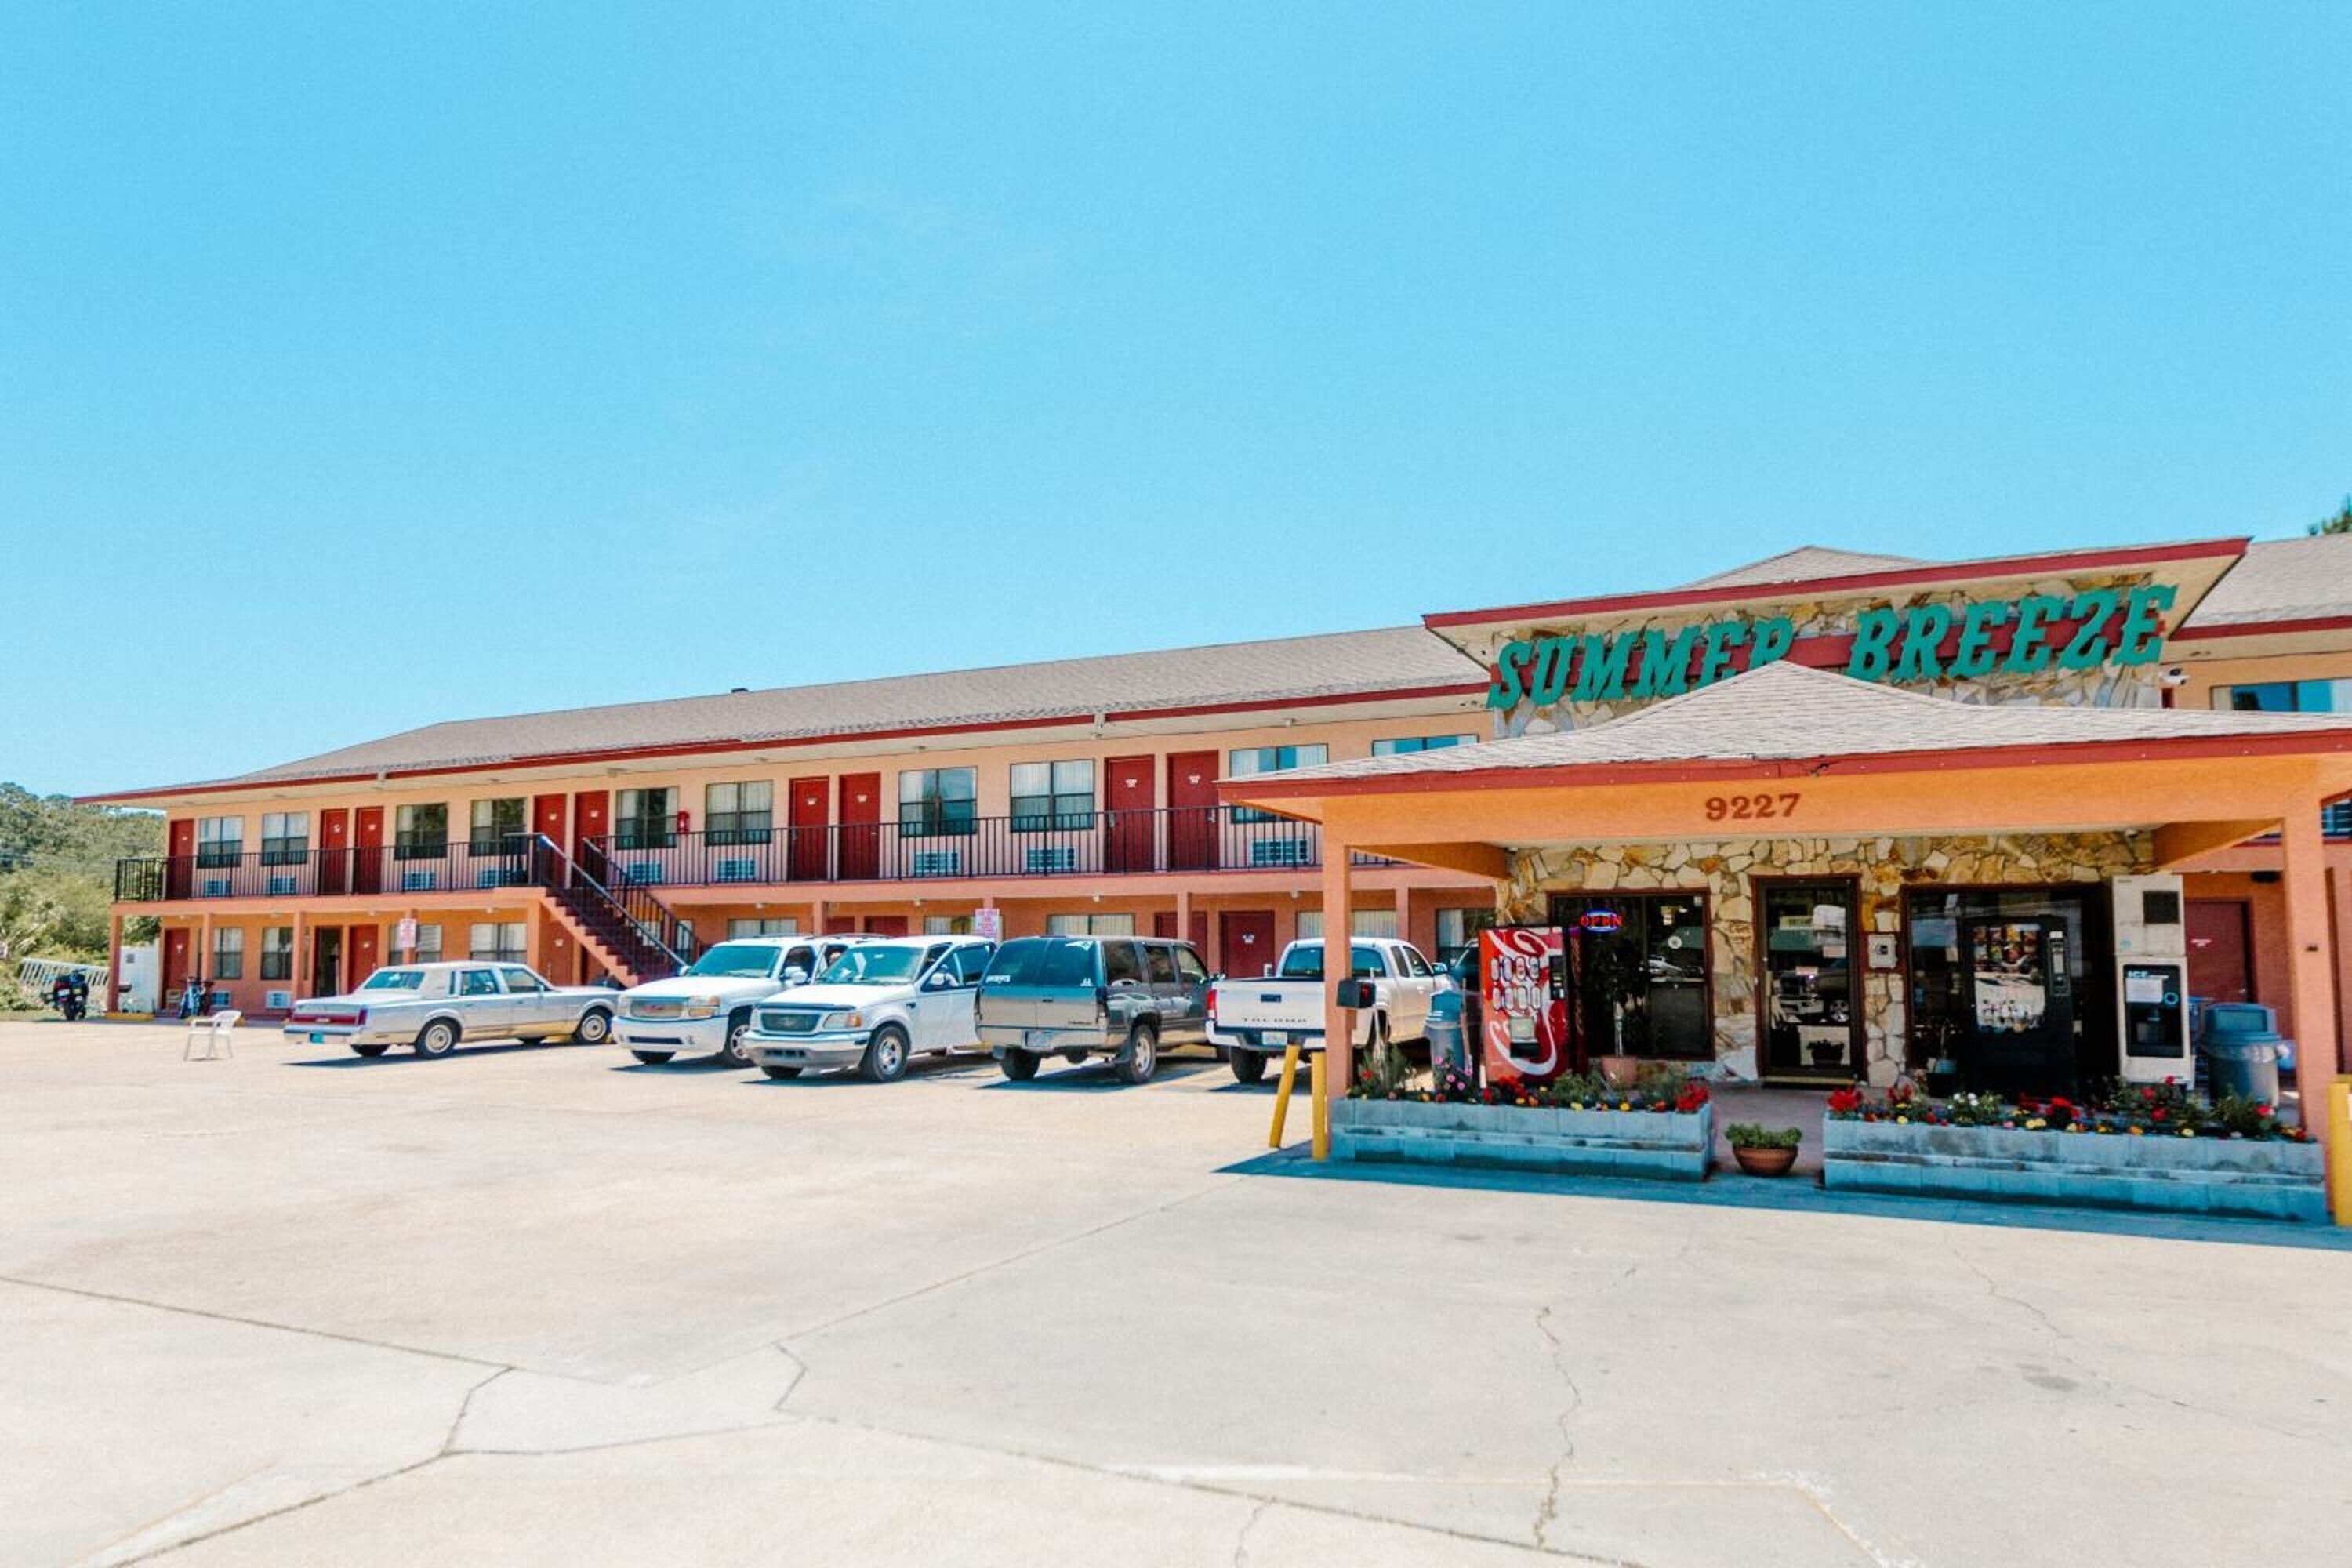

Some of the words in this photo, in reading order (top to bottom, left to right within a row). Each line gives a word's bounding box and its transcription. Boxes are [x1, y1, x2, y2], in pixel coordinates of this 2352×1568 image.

[1846, 583, 2180, 681] BREEZE
[1705, 793, 1801, 821] 9227
[1580, 915, 1623, 927] OPEN
